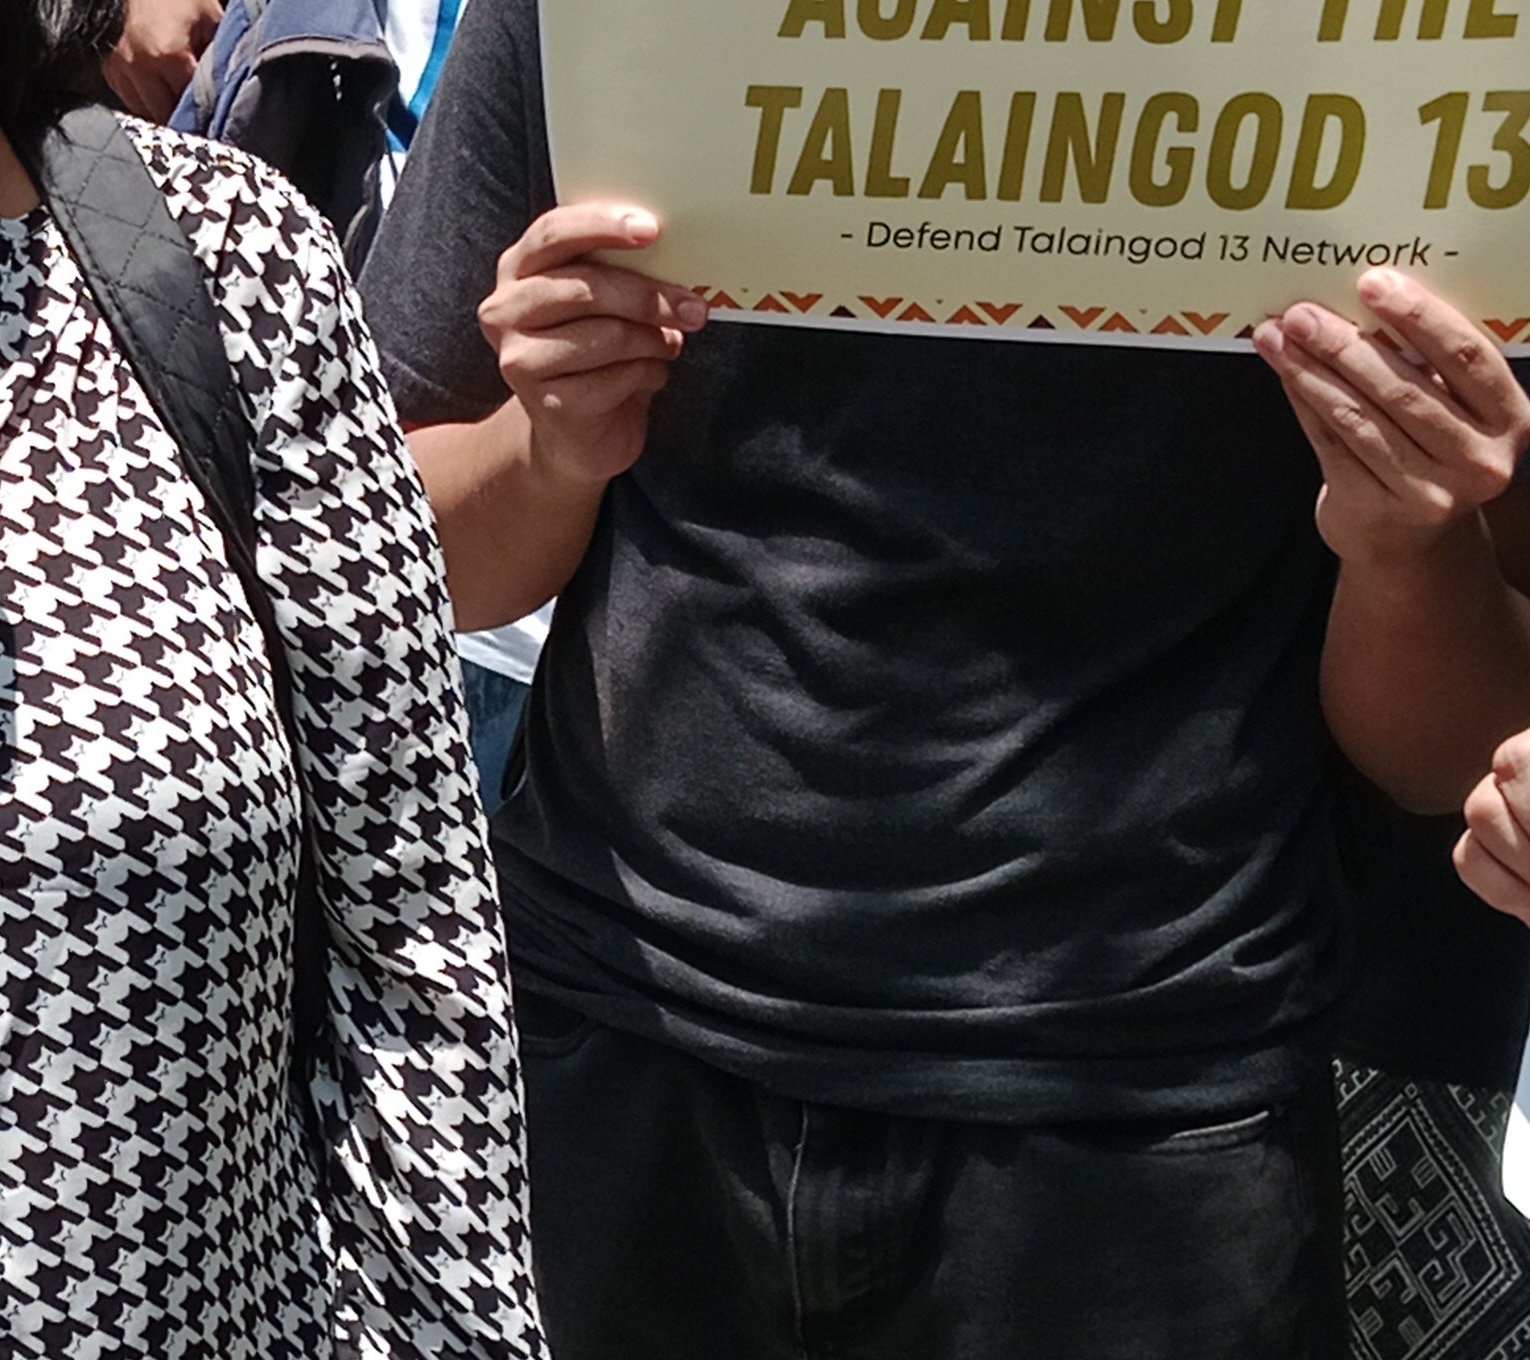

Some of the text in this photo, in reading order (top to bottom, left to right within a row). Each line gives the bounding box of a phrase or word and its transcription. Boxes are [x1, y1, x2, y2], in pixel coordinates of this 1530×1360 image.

[744, 84, 1530, 212] TALAINGOD 13
[865, 220, 1004, 253] Defend
[1012, 224, 1208, 266] Talaingod
[1218, 233, 1252, 263] 13
[1261, 234, 1432, 268] Network
